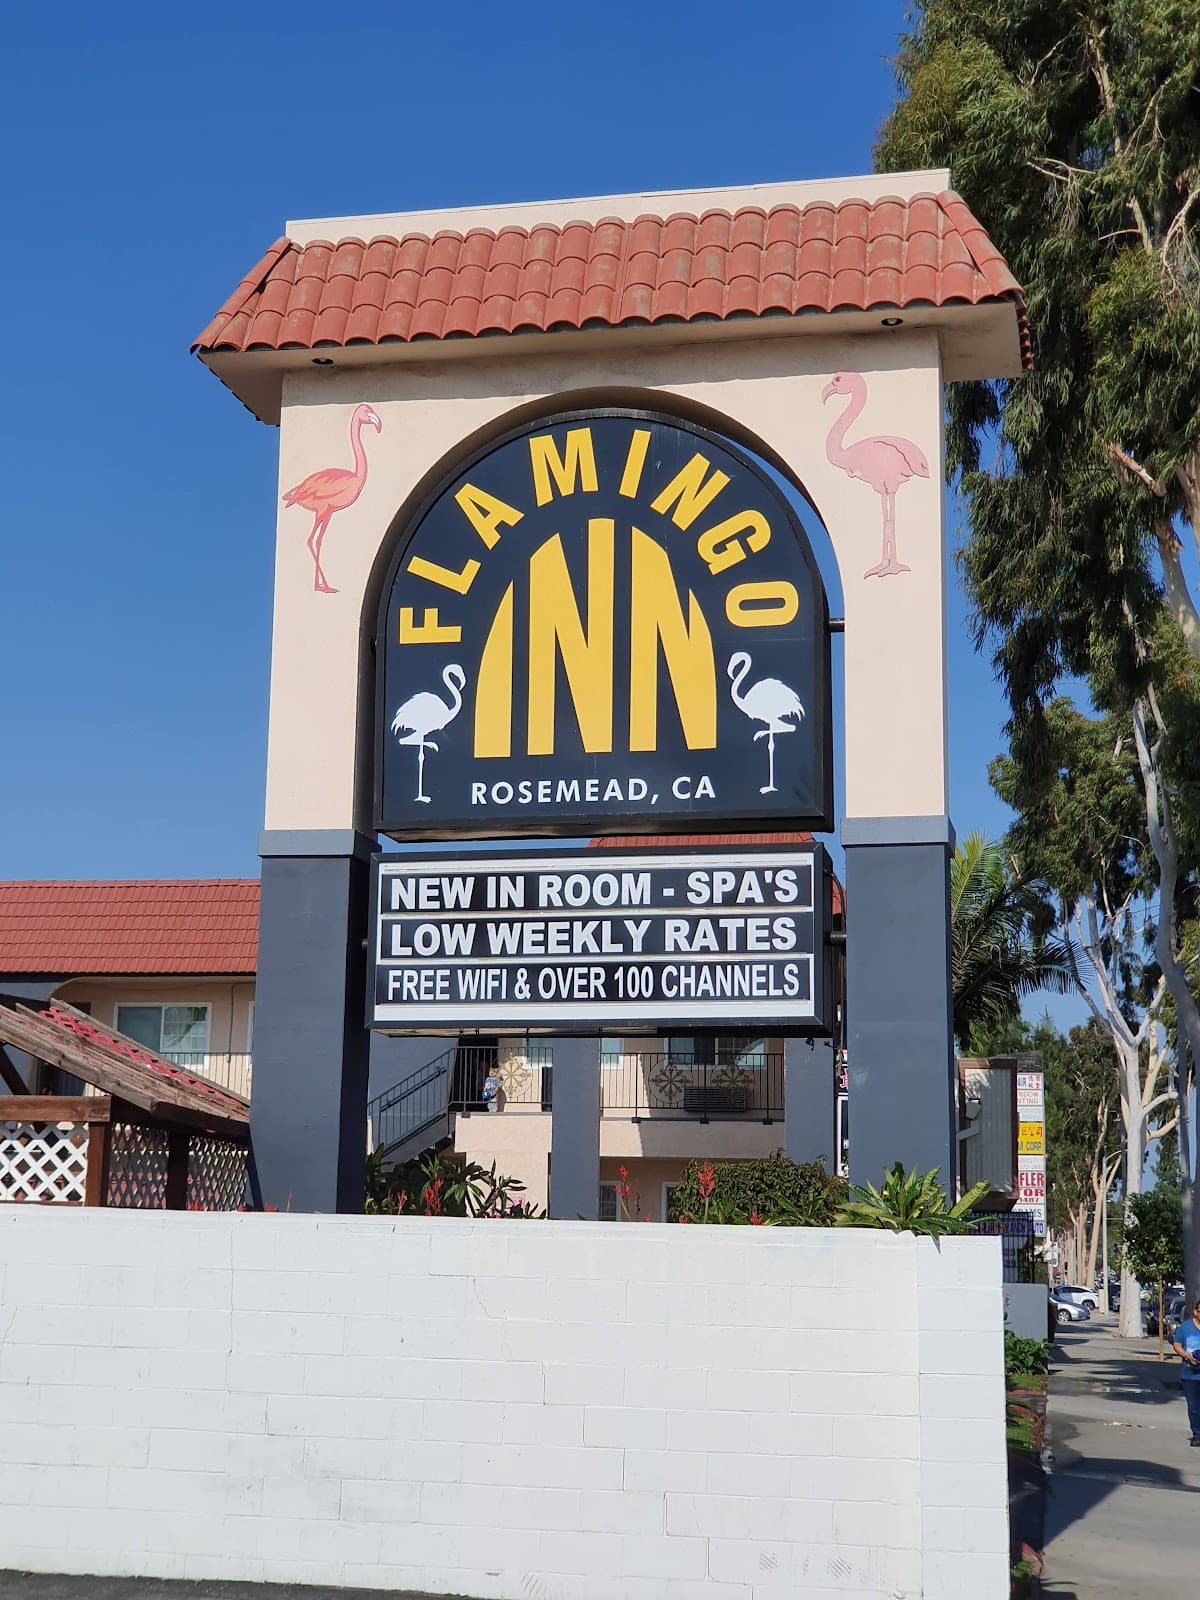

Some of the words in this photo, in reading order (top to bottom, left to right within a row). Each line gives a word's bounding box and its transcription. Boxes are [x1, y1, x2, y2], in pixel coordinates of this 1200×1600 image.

[400, 428, 798, 643] FLAMINGO
[474, 518, 717, 757] INN
[471, 779, 659, 805] ROSEMEAD,
[672, 776, 716, 799] CA
[391, 876, 475, 910] NEW
[486, 875, 525, 908] IN
[538, 872, 651, 907] ROOM
[686, 870, 799, 904] SPA'S
[391, 923, 476, 956] LOW
[486, 920, 652, 955] WEEKLY
[664, 917, 797, 952] RATES
[388, 969, 451, 1001] FREE
[457, 968, 508, 1000] WIFI
[514, 968, 532, 1000] &
[538, 967, 607, 1000] OVER
[614, 966, 654, 998] 100
[661, 964, 800, 998] CHANNELS
